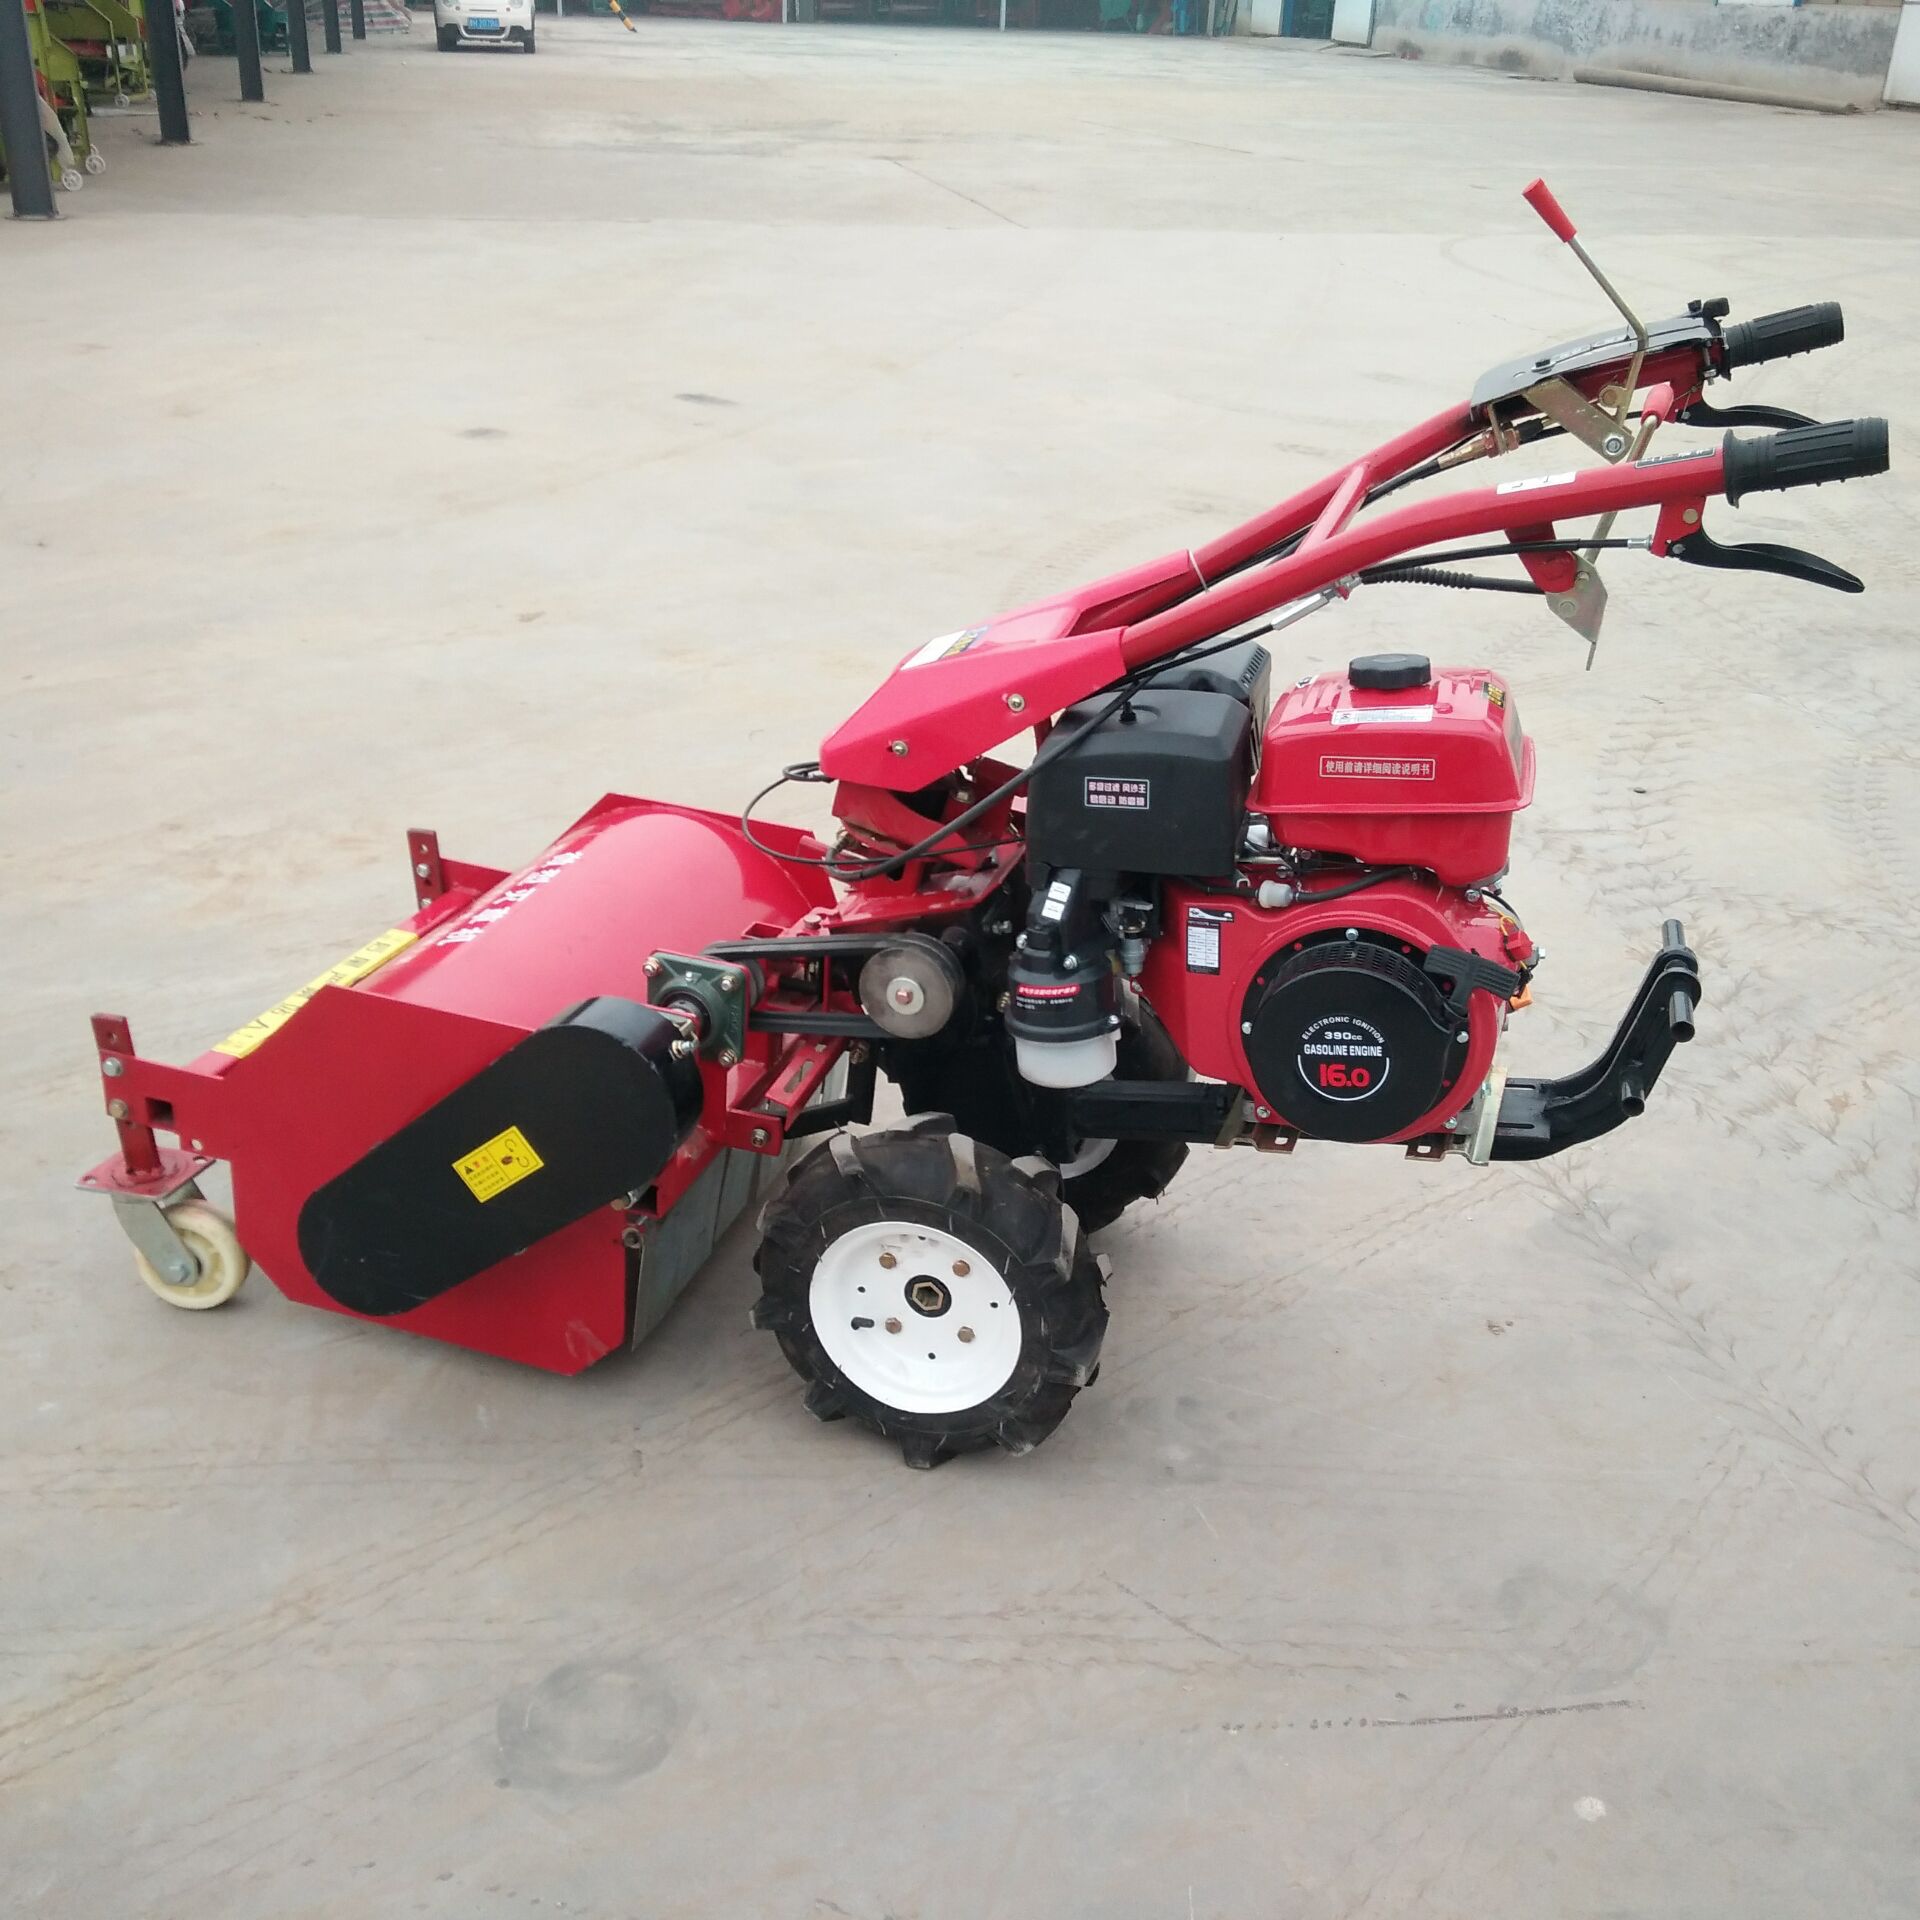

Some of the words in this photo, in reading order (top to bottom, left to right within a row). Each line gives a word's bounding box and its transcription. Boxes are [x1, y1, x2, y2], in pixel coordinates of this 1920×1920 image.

[1325, 760, 1430, 777] 使用前请详细阅读说明书
[1301, 1016, 1350, 1040] ELECTRONIC
[1352, 1018, 1385, 1044] IGNITION
[1303, 1043, 1348, 1056] GASOLINE
[1349, 1045, 1383, 1057] ENGINE
[1319, 1063, 1371, 1087] 16.0
